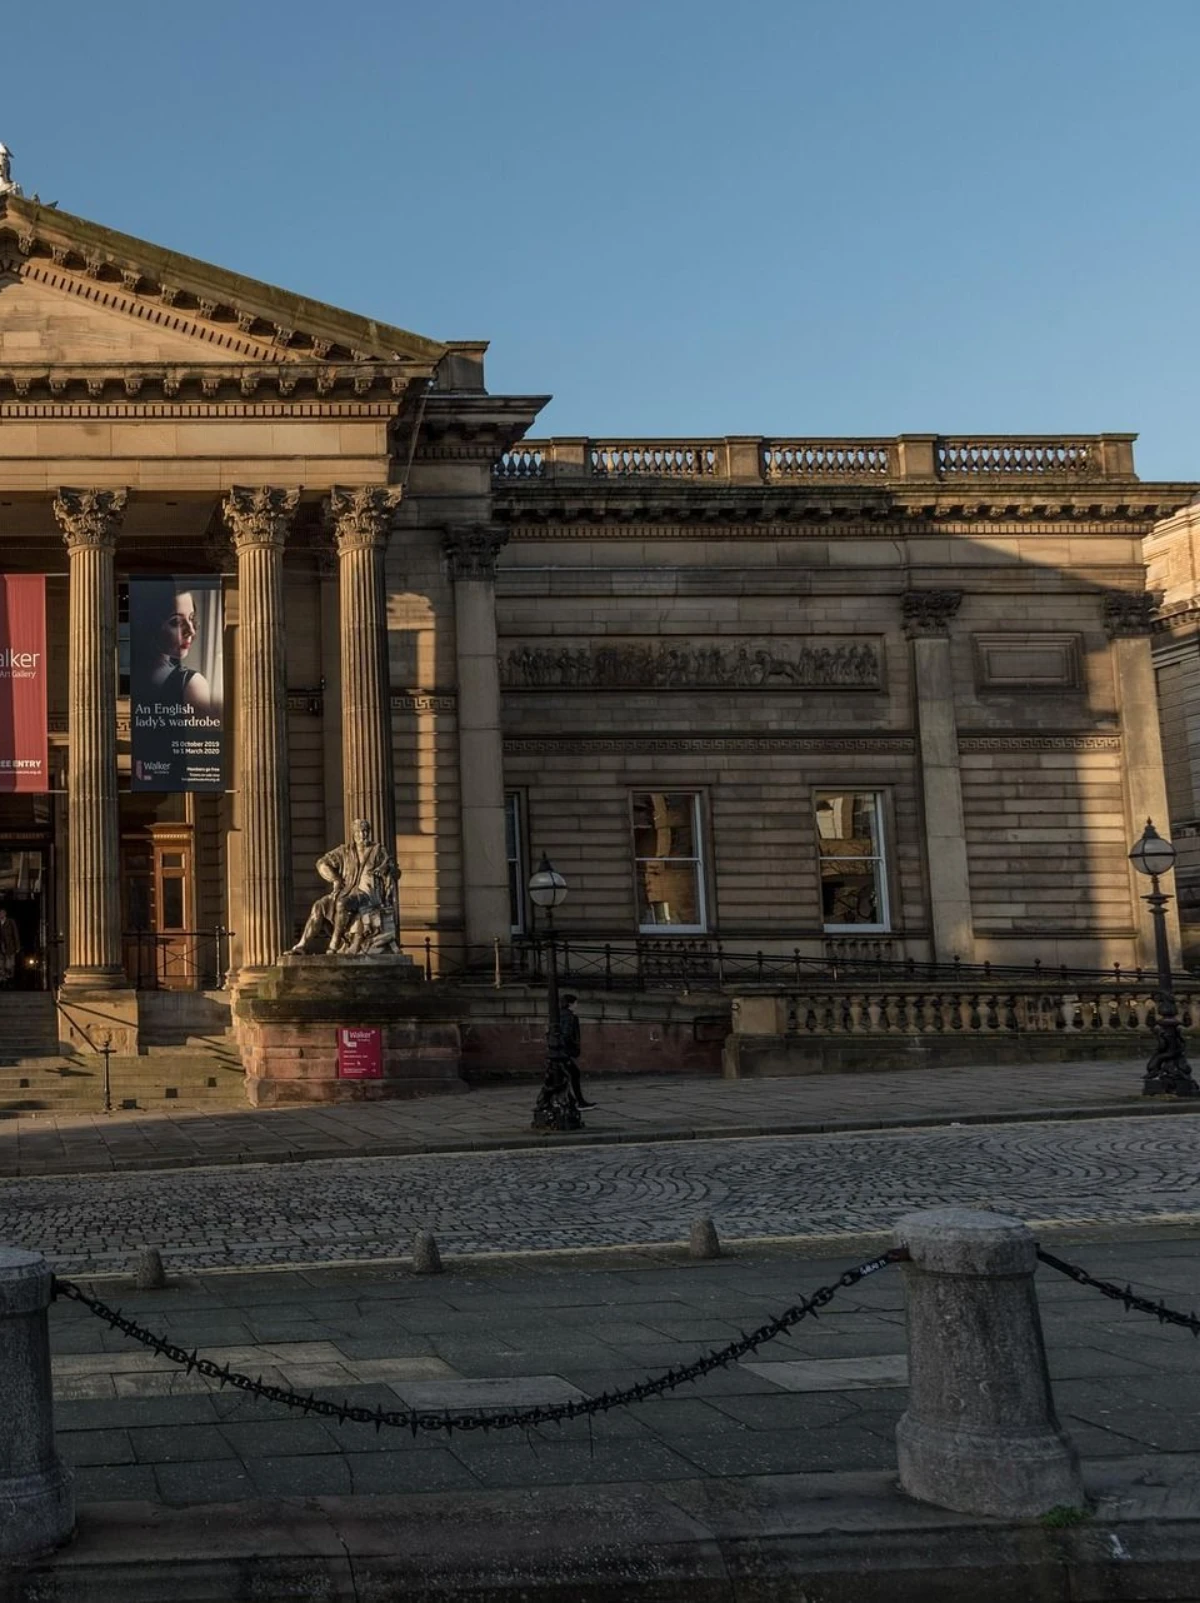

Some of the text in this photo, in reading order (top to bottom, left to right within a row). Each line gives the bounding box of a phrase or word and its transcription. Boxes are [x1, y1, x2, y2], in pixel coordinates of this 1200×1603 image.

[12, 670, 36, 680] Gallery
[134, 703, 194, 716] An English
[135, 716, 220, 730] lady's wardrobe
[12, 760, 42, 768] ENTRY
[144, 762, 170, 770] Walker
